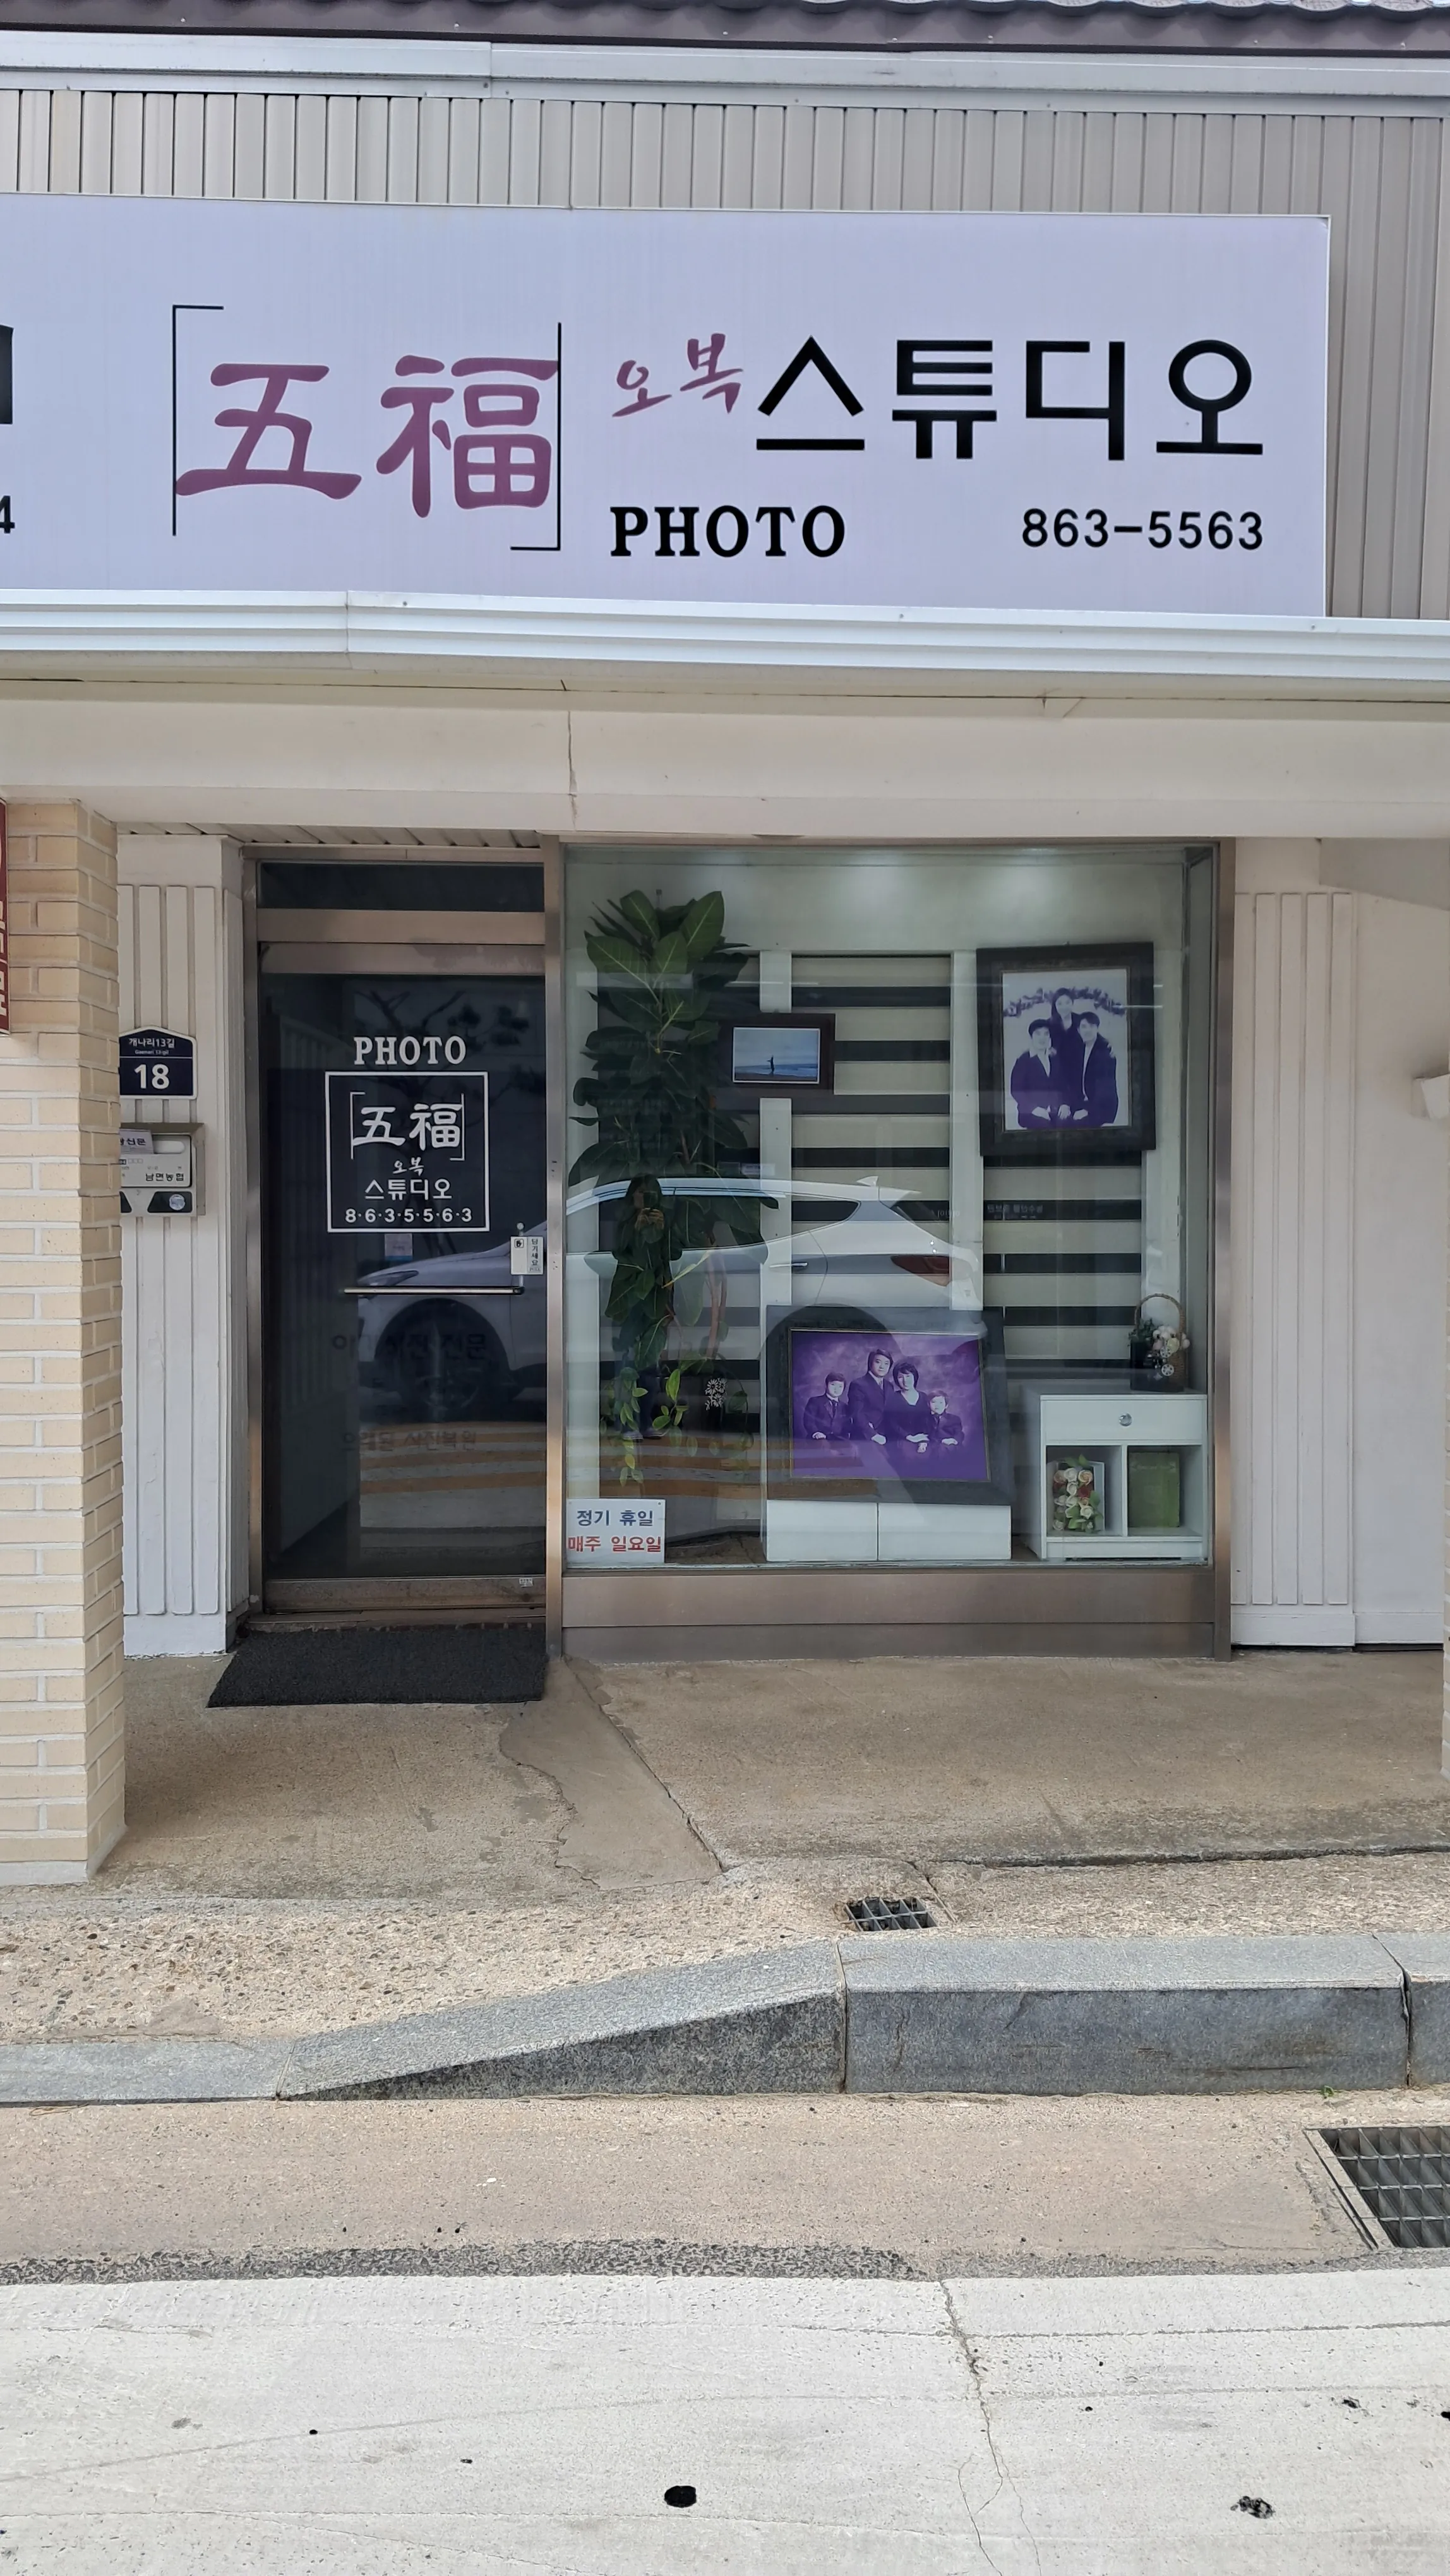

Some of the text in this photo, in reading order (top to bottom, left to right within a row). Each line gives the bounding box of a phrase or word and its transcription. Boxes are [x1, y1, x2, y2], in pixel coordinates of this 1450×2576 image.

[611, 333, 1263, 460] 오복 스튜디오
[176, 355, 558, 518] 五福
[610, 505, 845, 558] PHOTO
[1022, 508, 1263, 549] 863-5563
[129, 1037, 175, 1049] 개나리13길
[354, 1035, 466, 1065] PHOTO
[134, 1063, 170, 1090] 18
[353, 1104, 463, 1151] 五福
[145, 1173, 184, 1182] 남면농협
[393, 1157, 424, 1176] 오복
[365, 1179, 452, 1200] 스튜디오
[577, 1510, 653, 1526] 정기 휴일
[568, 1536, 662, 1553] 매주 일요일
